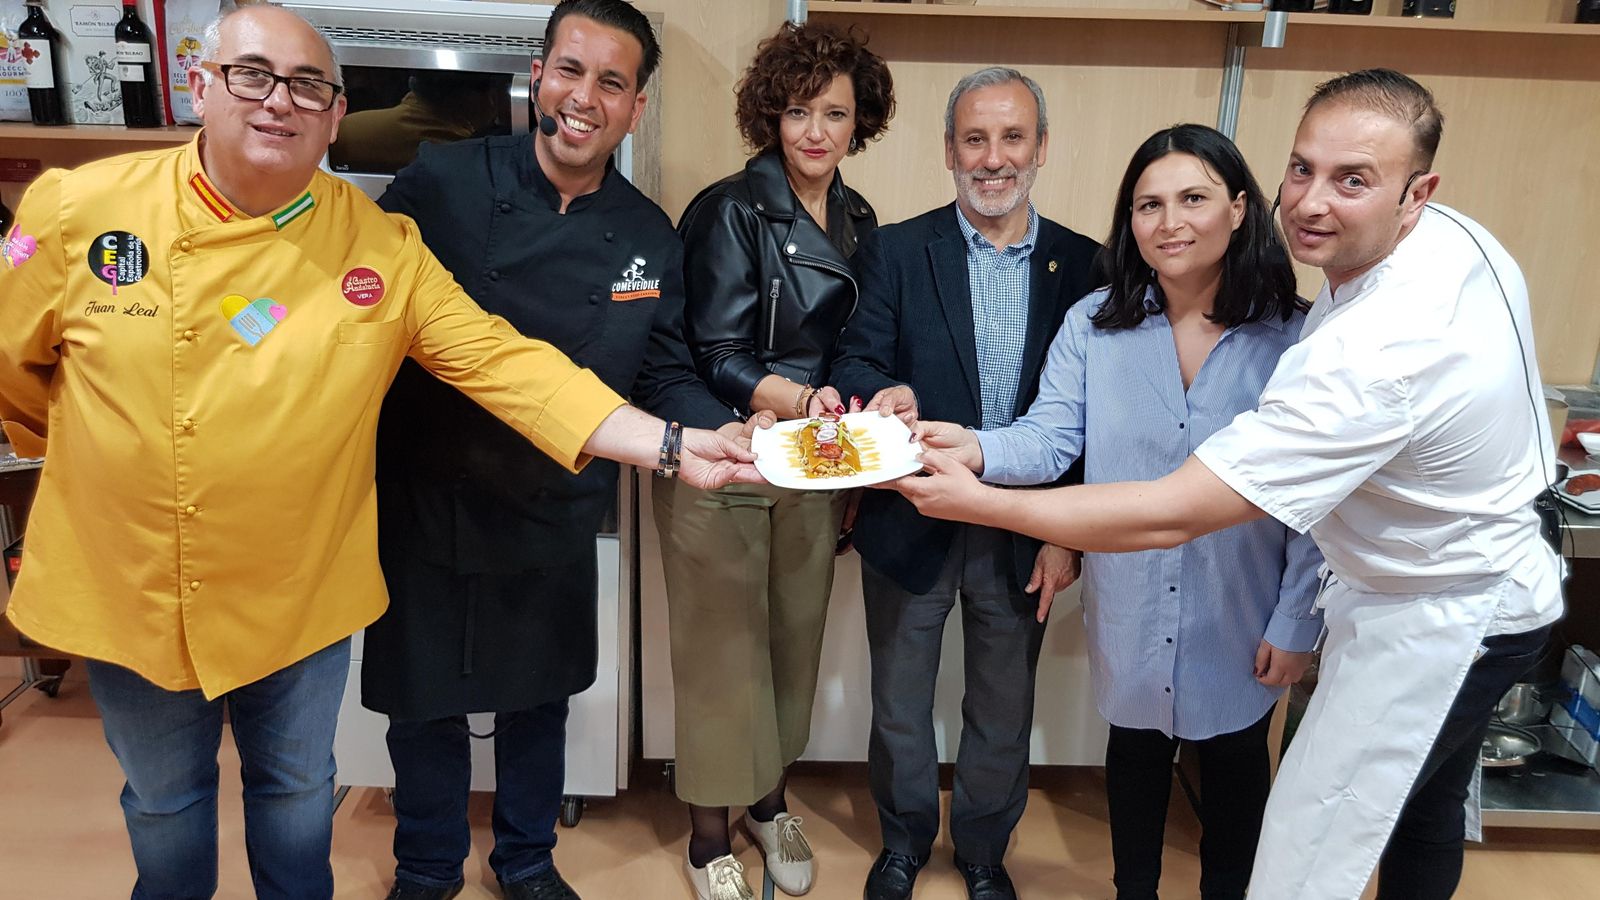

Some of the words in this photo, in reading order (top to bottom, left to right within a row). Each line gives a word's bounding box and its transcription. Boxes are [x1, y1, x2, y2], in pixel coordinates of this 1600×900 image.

[118, 256, 126, 281] Capital
[126, 250, 135, 282] Española
[352, 277, 378, 285] Gastro
[612, 280, 660, 292] COMEVEIDILE
[85, 301, 116, 317] Juan
[123, 302, 159, 318] Leal
